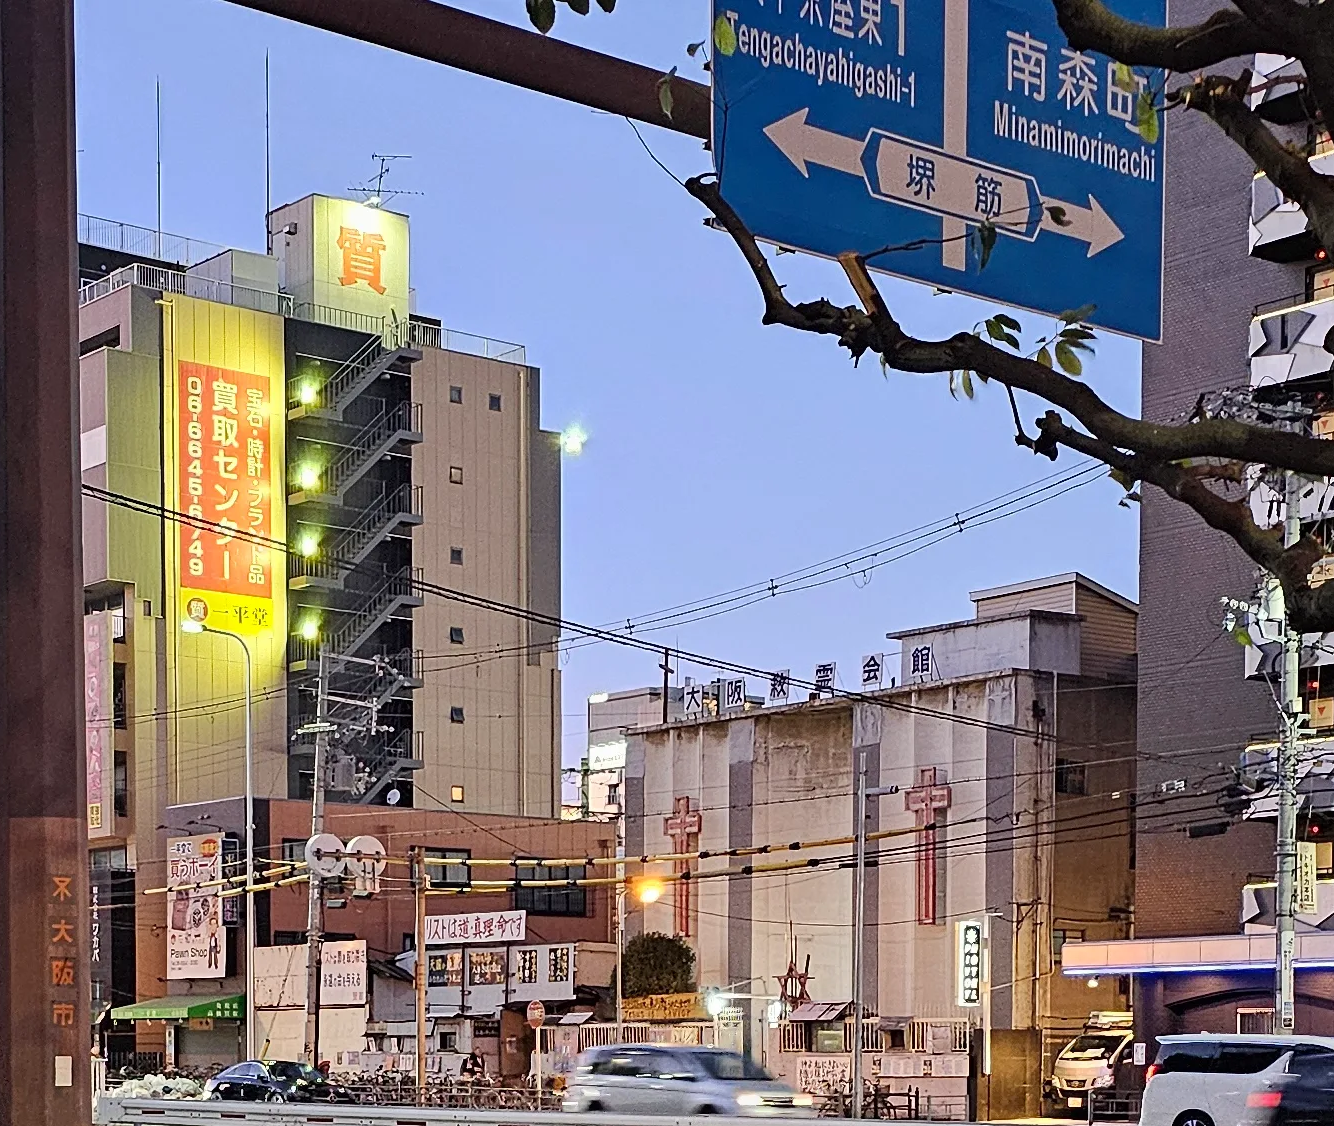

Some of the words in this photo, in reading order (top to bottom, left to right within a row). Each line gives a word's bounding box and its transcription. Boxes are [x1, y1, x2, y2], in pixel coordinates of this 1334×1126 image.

[725, 10, 915, 108] Tengachayahigashi-1
[1006, 30, 1148, 134] 南森町
[994, 99, 1155, 182] Minamimorimachi
[336, 224, 387, 295] 質
[211, 377, 240, 580] 買取センター
[684, 644, 933, 712] 大阪救霊会館
